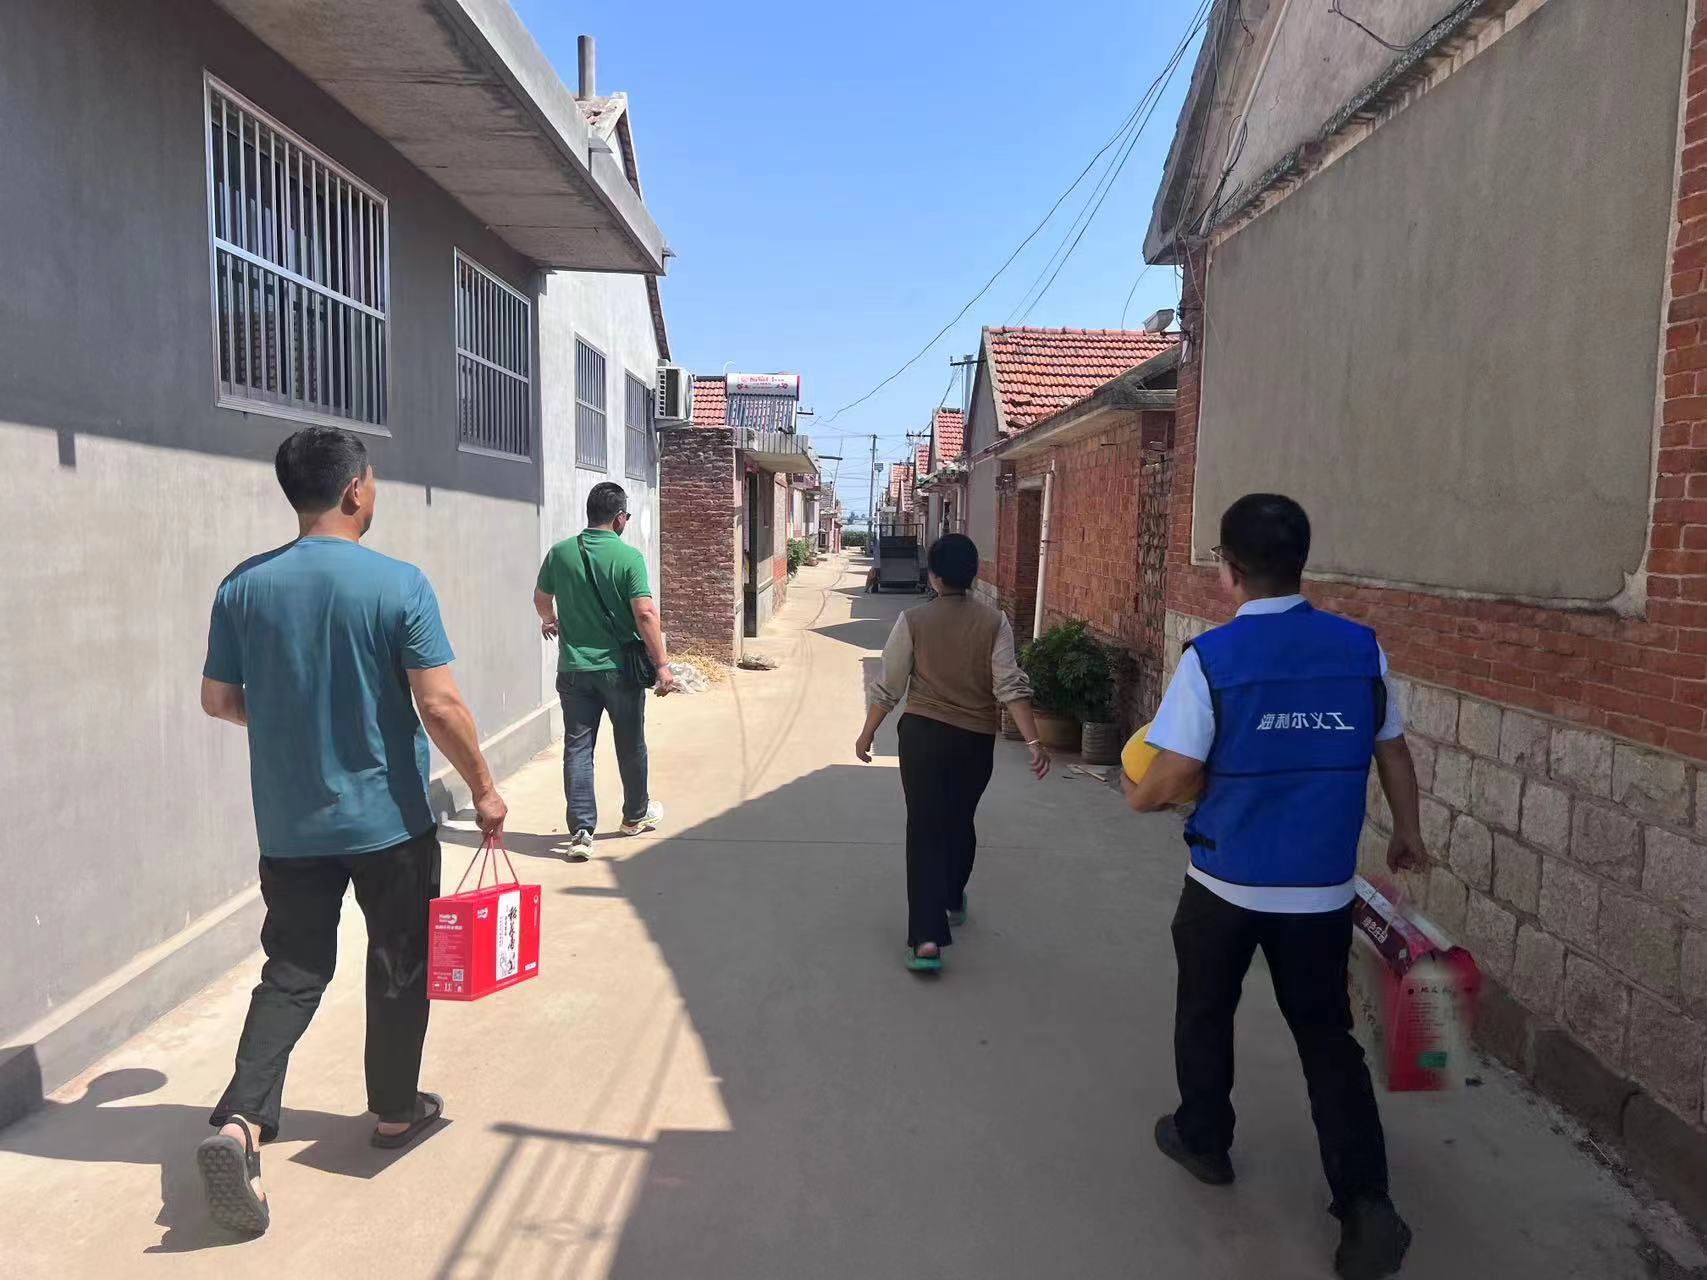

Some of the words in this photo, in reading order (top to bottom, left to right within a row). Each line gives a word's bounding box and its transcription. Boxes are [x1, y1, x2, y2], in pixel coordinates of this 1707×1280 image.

[1257, 711, 1355, 730] 海利尔义工
